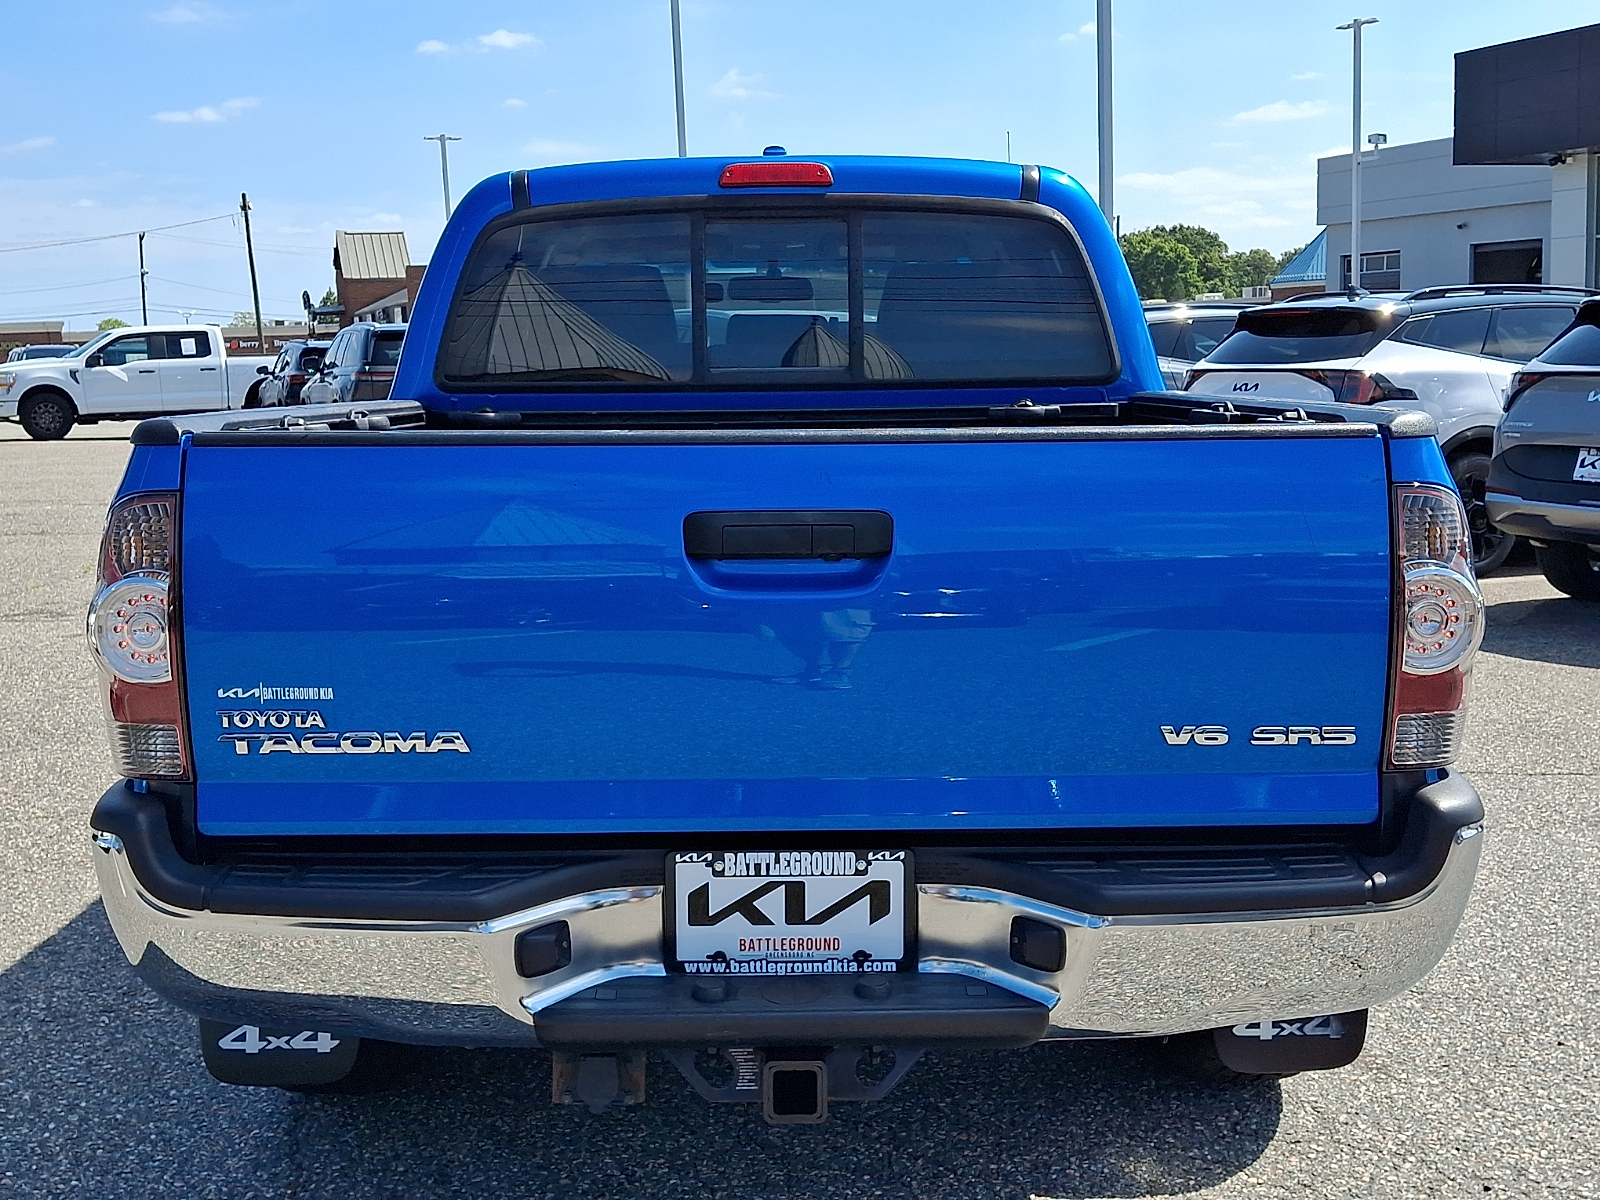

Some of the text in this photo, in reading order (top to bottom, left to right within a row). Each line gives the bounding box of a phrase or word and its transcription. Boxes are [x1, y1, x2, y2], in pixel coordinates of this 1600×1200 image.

[1232, 382, 1260, 392] KIA
[217, 687, 334, 700] KIA BATTLEGROUND KIA
[216, 710, 326, 729] TOYOTA
[217, 731, 471, 755] TACOMA
[1160, 725, 1357, 745] V6 SR5
[675, 852, 713, 863] KIA
[724, 851, 856, 877] BATTLEGROUND
[868, 851, 906, 861] KIA
[687, 879, 892, 927] KIA
[739, 937, 841, 952] BATTLEGROUND
[684, 959, 897, 976] www.battlegroundkia.com
[1232, 1015, 1345, 1040] 4x4
[218, 1024, 341, 1054] 4x4
